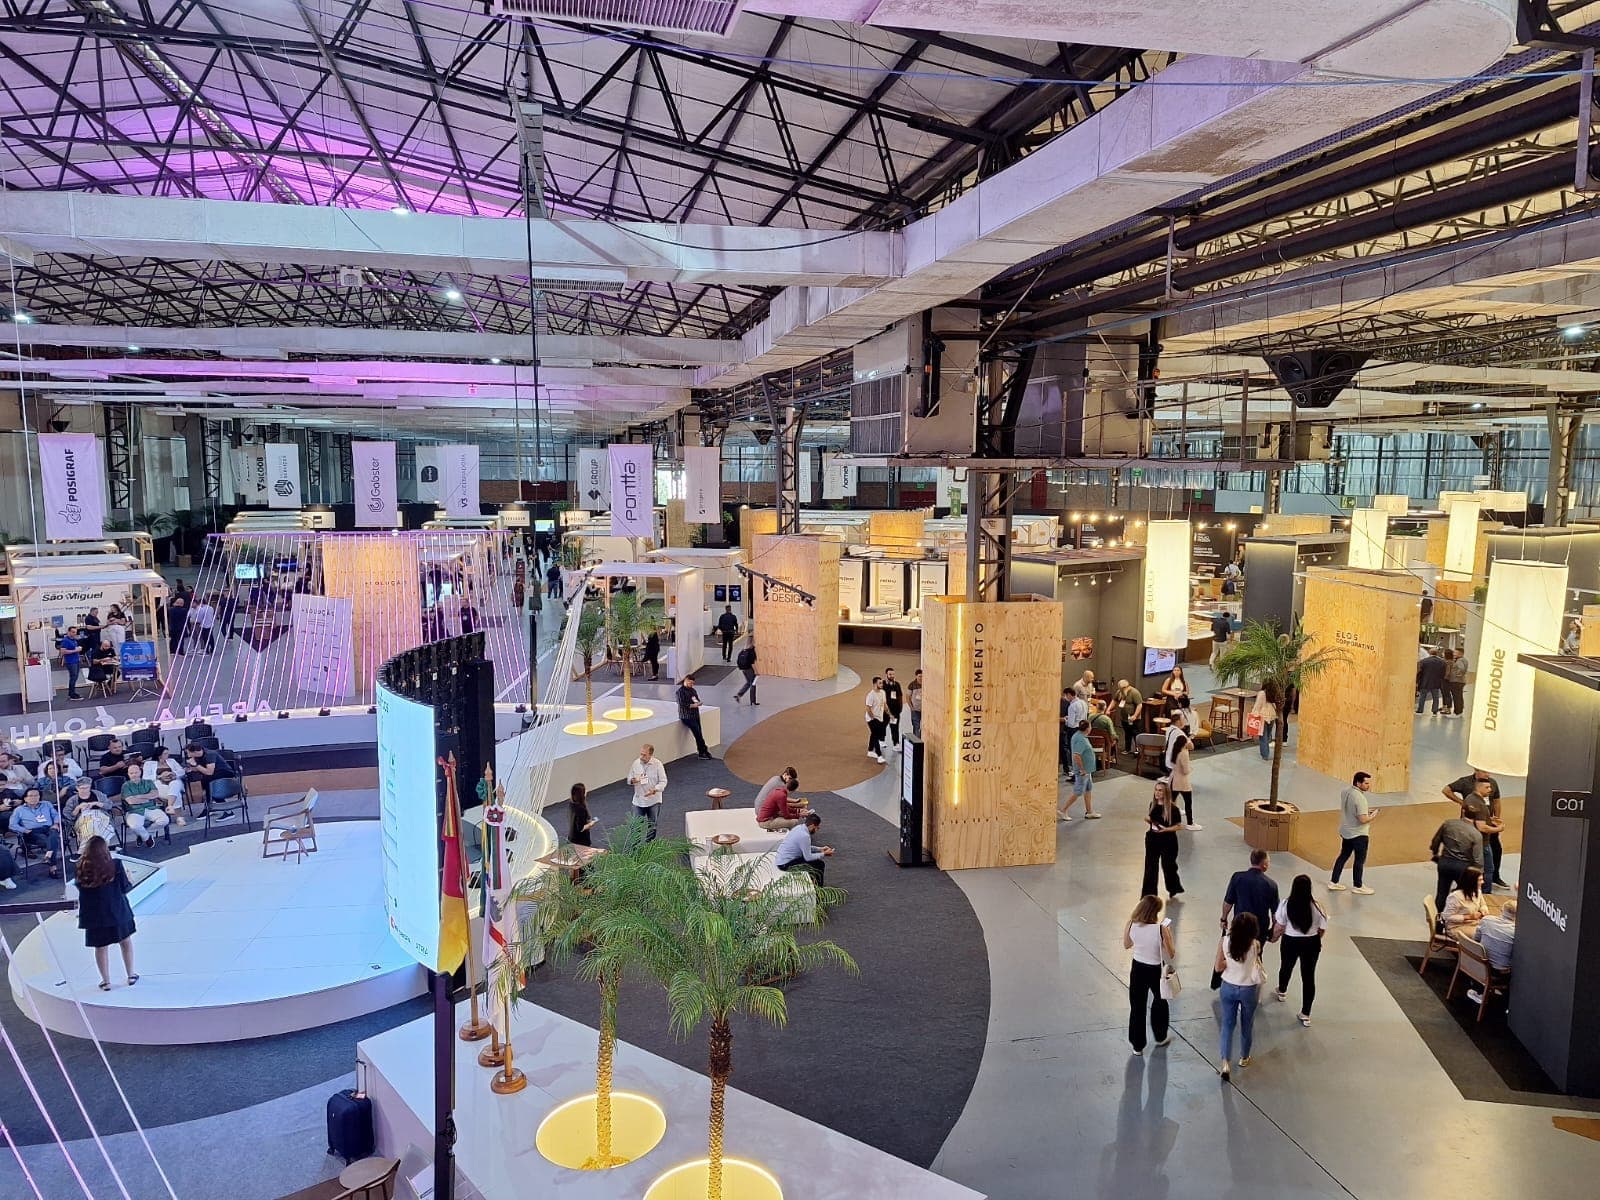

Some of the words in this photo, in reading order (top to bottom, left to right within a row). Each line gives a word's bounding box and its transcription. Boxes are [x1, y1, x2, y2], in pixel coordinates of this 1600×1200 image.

[65, 448, 78, 502] POSIGRAF
[256, 456, 265, 483] SICOOB
[370, 457, 381, 497] Gabster
[591, 459, 599, 485] GROUP
[42, 591, 64, 602] São
[66, 591, 104, 602] Miguel
[1335, 637, 1376, 652] CORPORATIVO
[1336, 630, 1359, 641] ELOS
[972, 622, 984, 763] CONHECIMENTO
[962, 704, 972, 763] ARENA
[1555, 798, 1585, 812] C01
